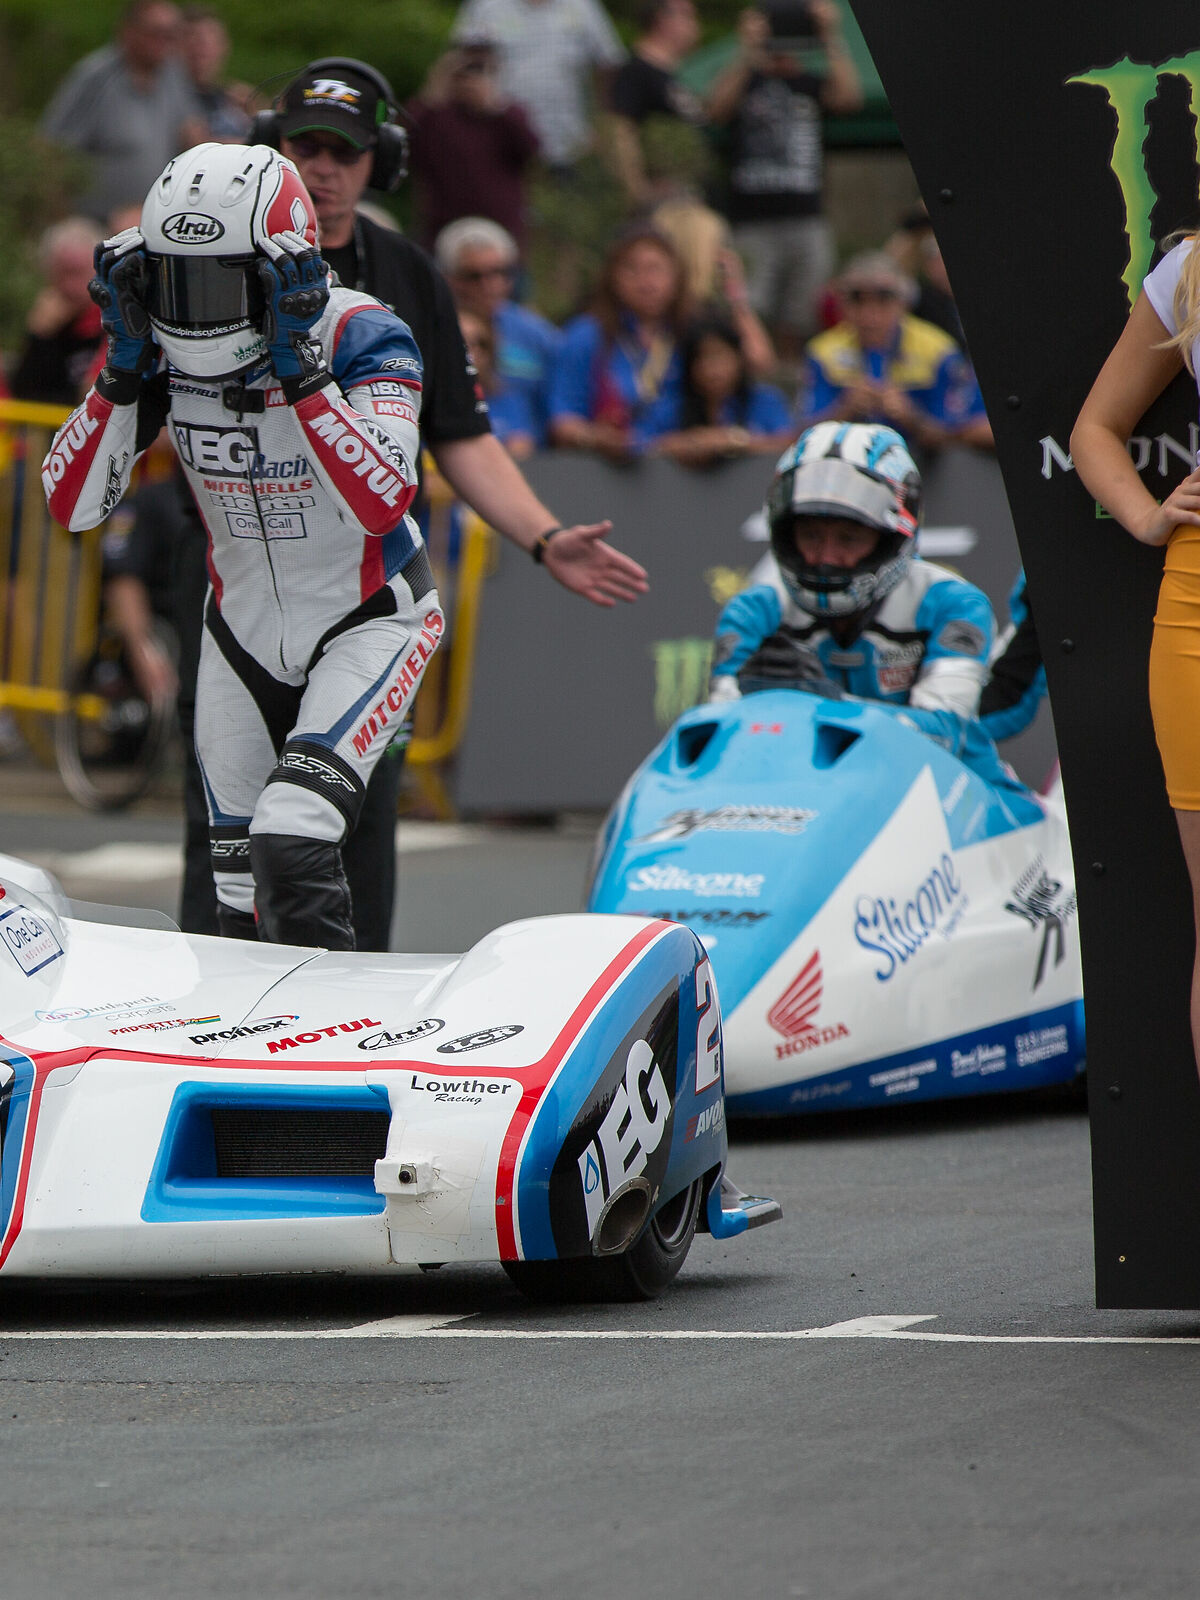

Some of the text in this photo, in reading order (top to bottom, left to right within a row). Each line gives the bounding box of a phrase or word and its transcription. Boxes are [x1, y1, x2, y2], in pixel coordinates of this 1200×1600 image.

[165, 215, 217, 237] Arai
[168, 381, 220, 399] ANSFIELD
[308, 412, 404, 509] MOTUL
[203, 479, 313, 495] MITCHELLS
[267, 517, 292, 529] Call
[351, 609, 445, 759] MITCHELLS
[627, 864, 765, 892] Silicone
[855, 853, 960, 982] Silicone
[6, 926, 31, 949] One
[106, 1003, 176, 1022] carpets
[108, 1019, 185, 1035] PADGETT'S
[188, 1019, 291, 1045] proflex
[265, 1018, 382, 1054] MOTUL
[367, 1019, 435, 1049] Arai
[442, 1028, 517, 1052] LCR
[775, 1022, 850, 1060] HONDA
[411, 1075, 512, 1095] Lowther
[434, 1093, 482, 1106] Racing
